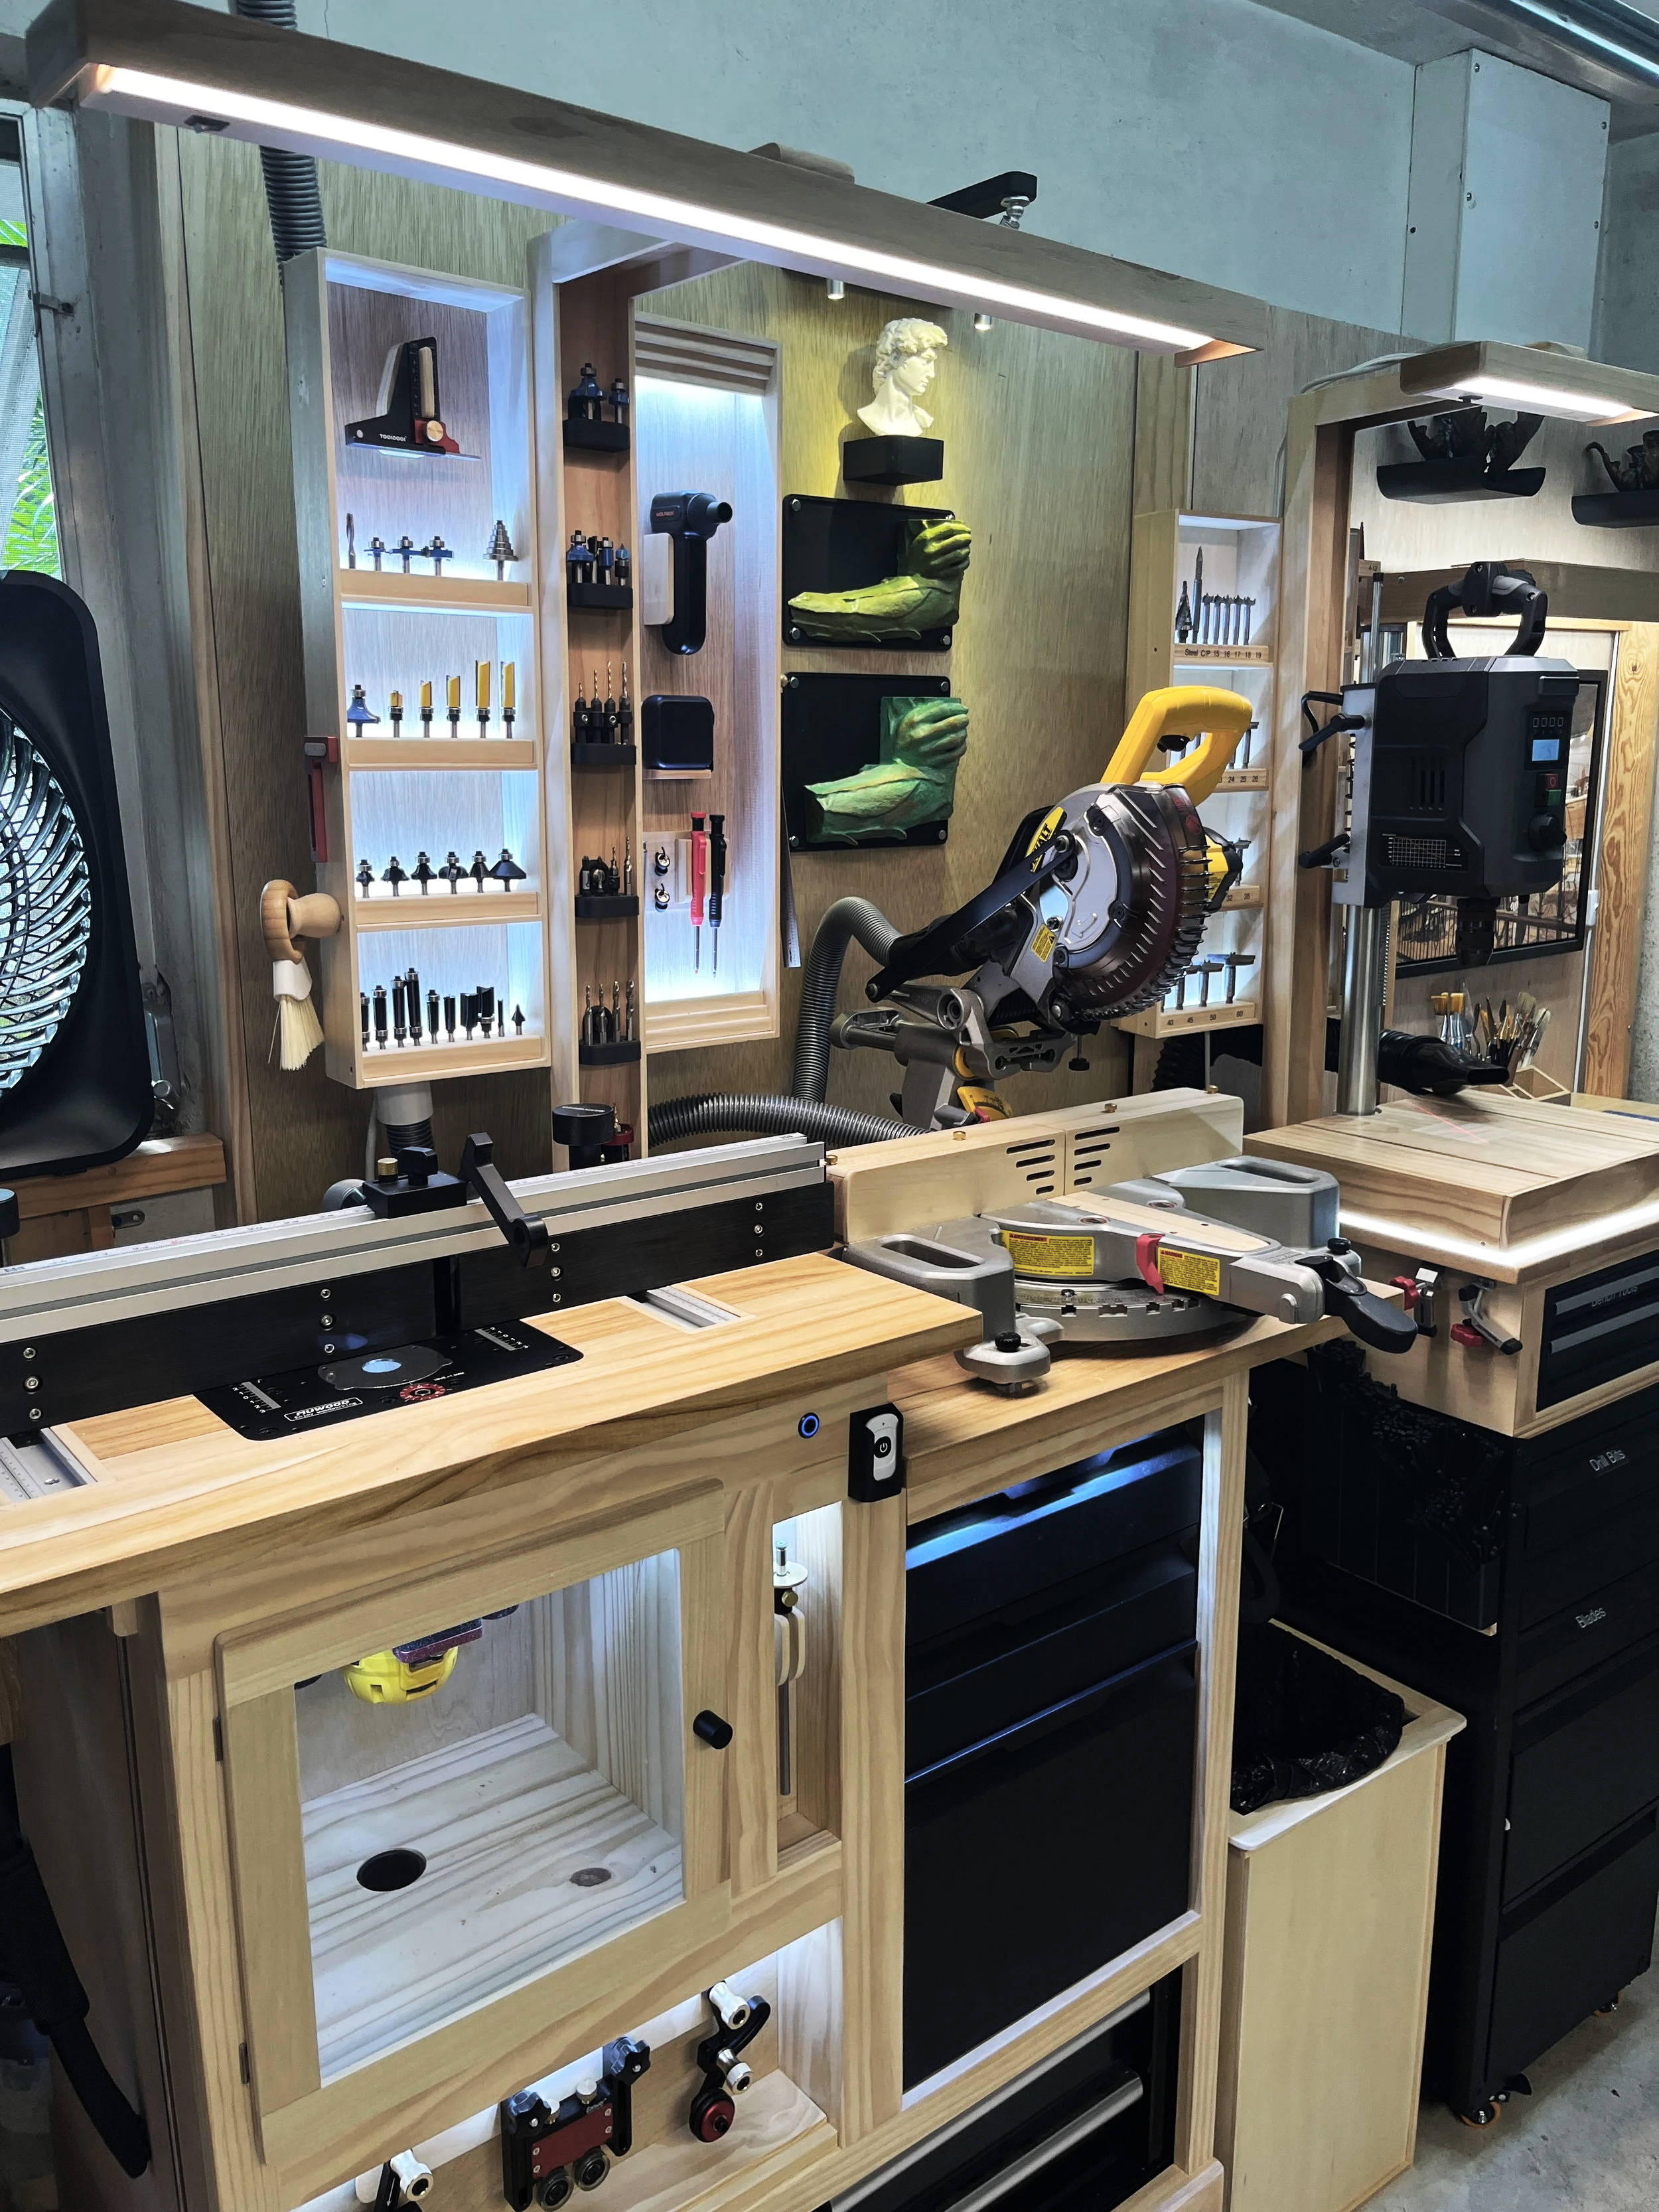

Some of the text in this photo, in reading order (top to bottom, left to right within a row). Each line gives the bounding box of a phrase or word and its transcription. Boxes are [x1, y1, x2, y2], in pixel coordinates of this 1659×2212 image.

[296, 1400, 350, 1416] MUWOOD
[1589, 1450, 1625, 1471] Drill Bits
[1575, 1607, 1607, 1628] Blades
